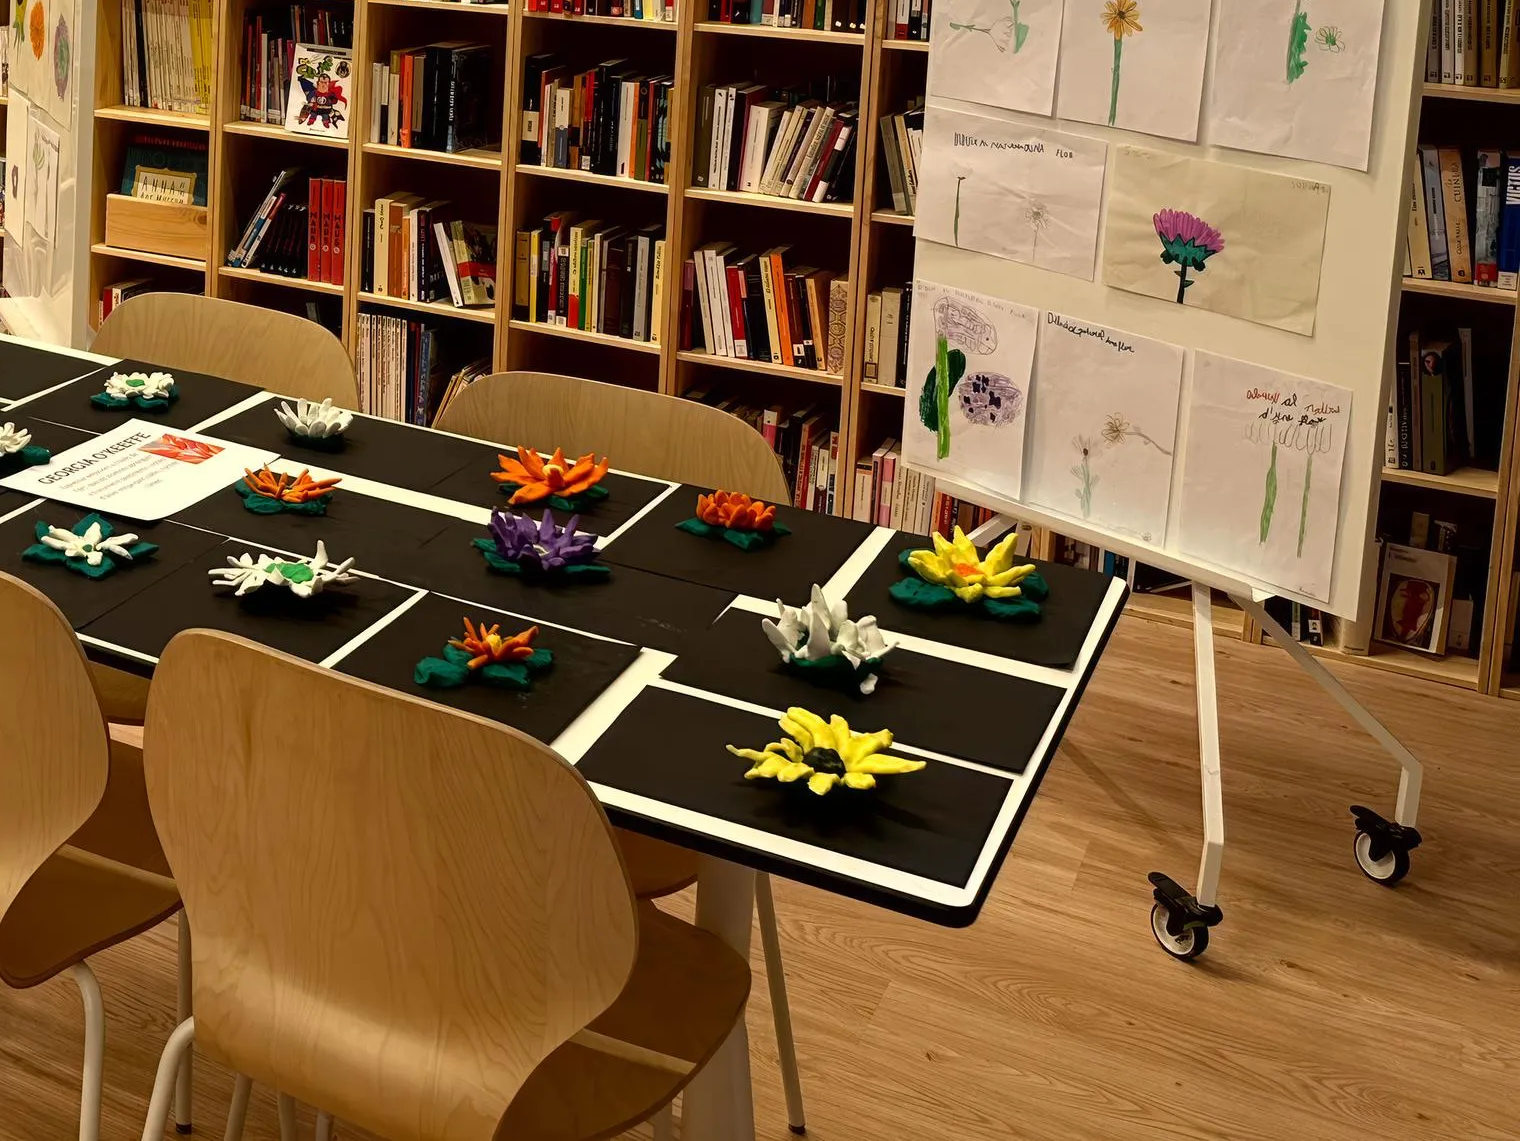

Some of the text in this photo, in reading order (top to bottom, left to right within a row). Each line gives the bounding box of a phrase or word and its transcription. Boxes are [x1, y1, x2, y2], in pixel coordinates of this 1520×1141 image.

[1281, 392, 1298, 407] al
[37, 452, 100, 486] GEORGIA
[93, 431, 152, 461] O'KEEFFE
